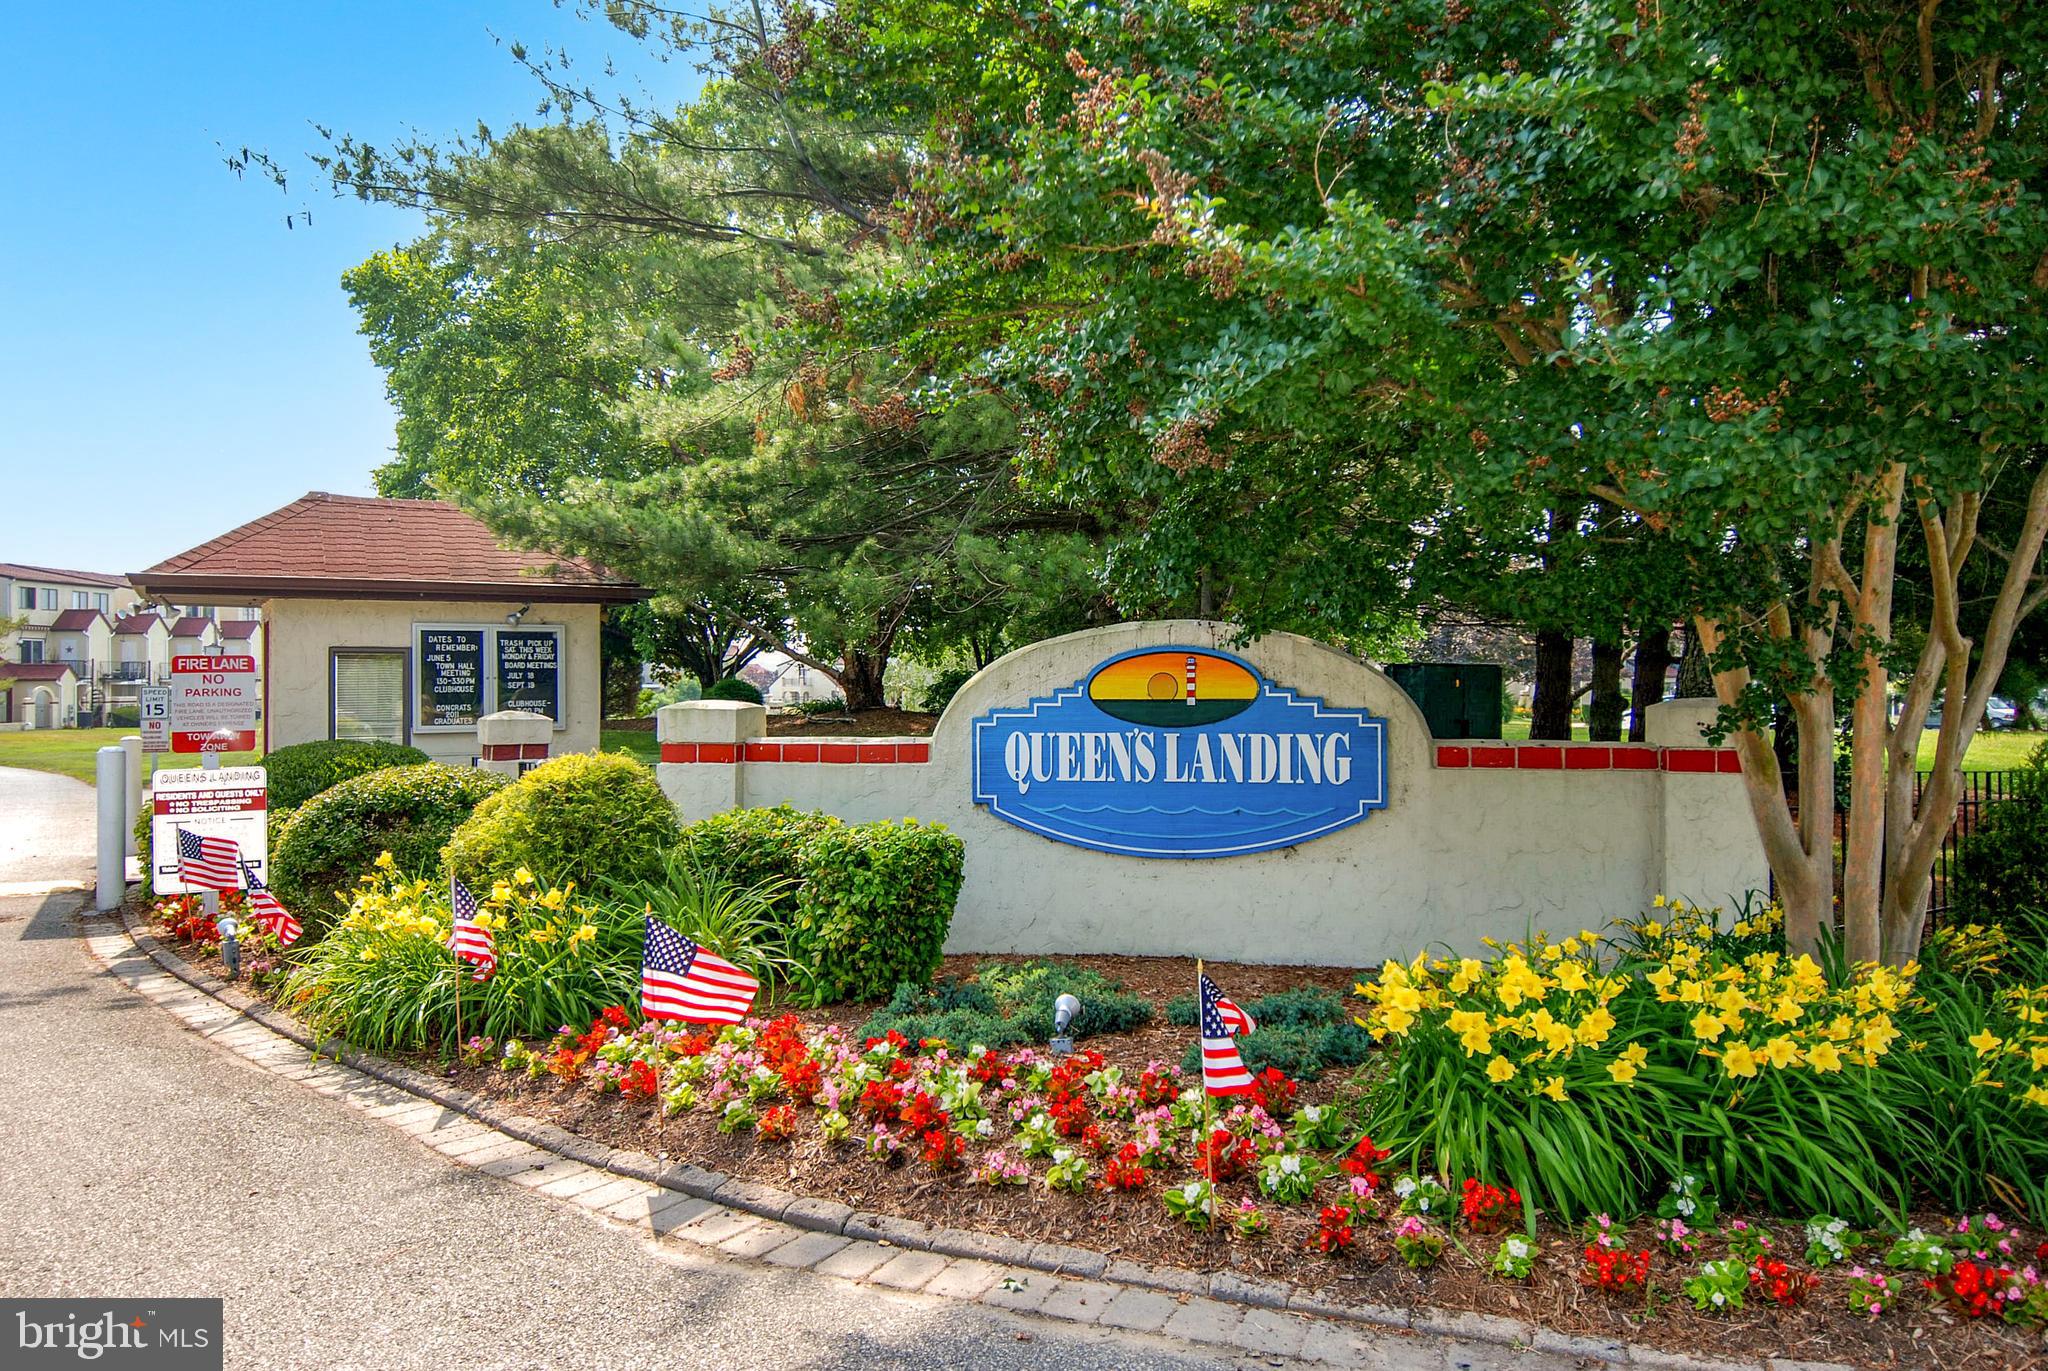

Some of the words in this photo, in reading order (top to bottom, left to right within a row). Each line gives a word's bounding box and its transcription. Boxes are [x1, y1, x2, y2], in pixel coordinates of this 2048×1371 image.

[178, 658, 208, 670] FIRE
[212, 658, 248, 670] LANE
[202, 674, 224, 684] NO
[185, 688, 242, 697] PARKING
[146, 704, 164, 715] 15
[1004, 728, 1156, 794] QUEEN'S
[1164, 732, 1352, 786] LANDING
[160, 772, 206, 784] QUEENS
[210, 770, 260, 782] LANDING
[156, 792, 197, 800] RESIDENTS
[191, 798, 252, 806] TRESPASSING
